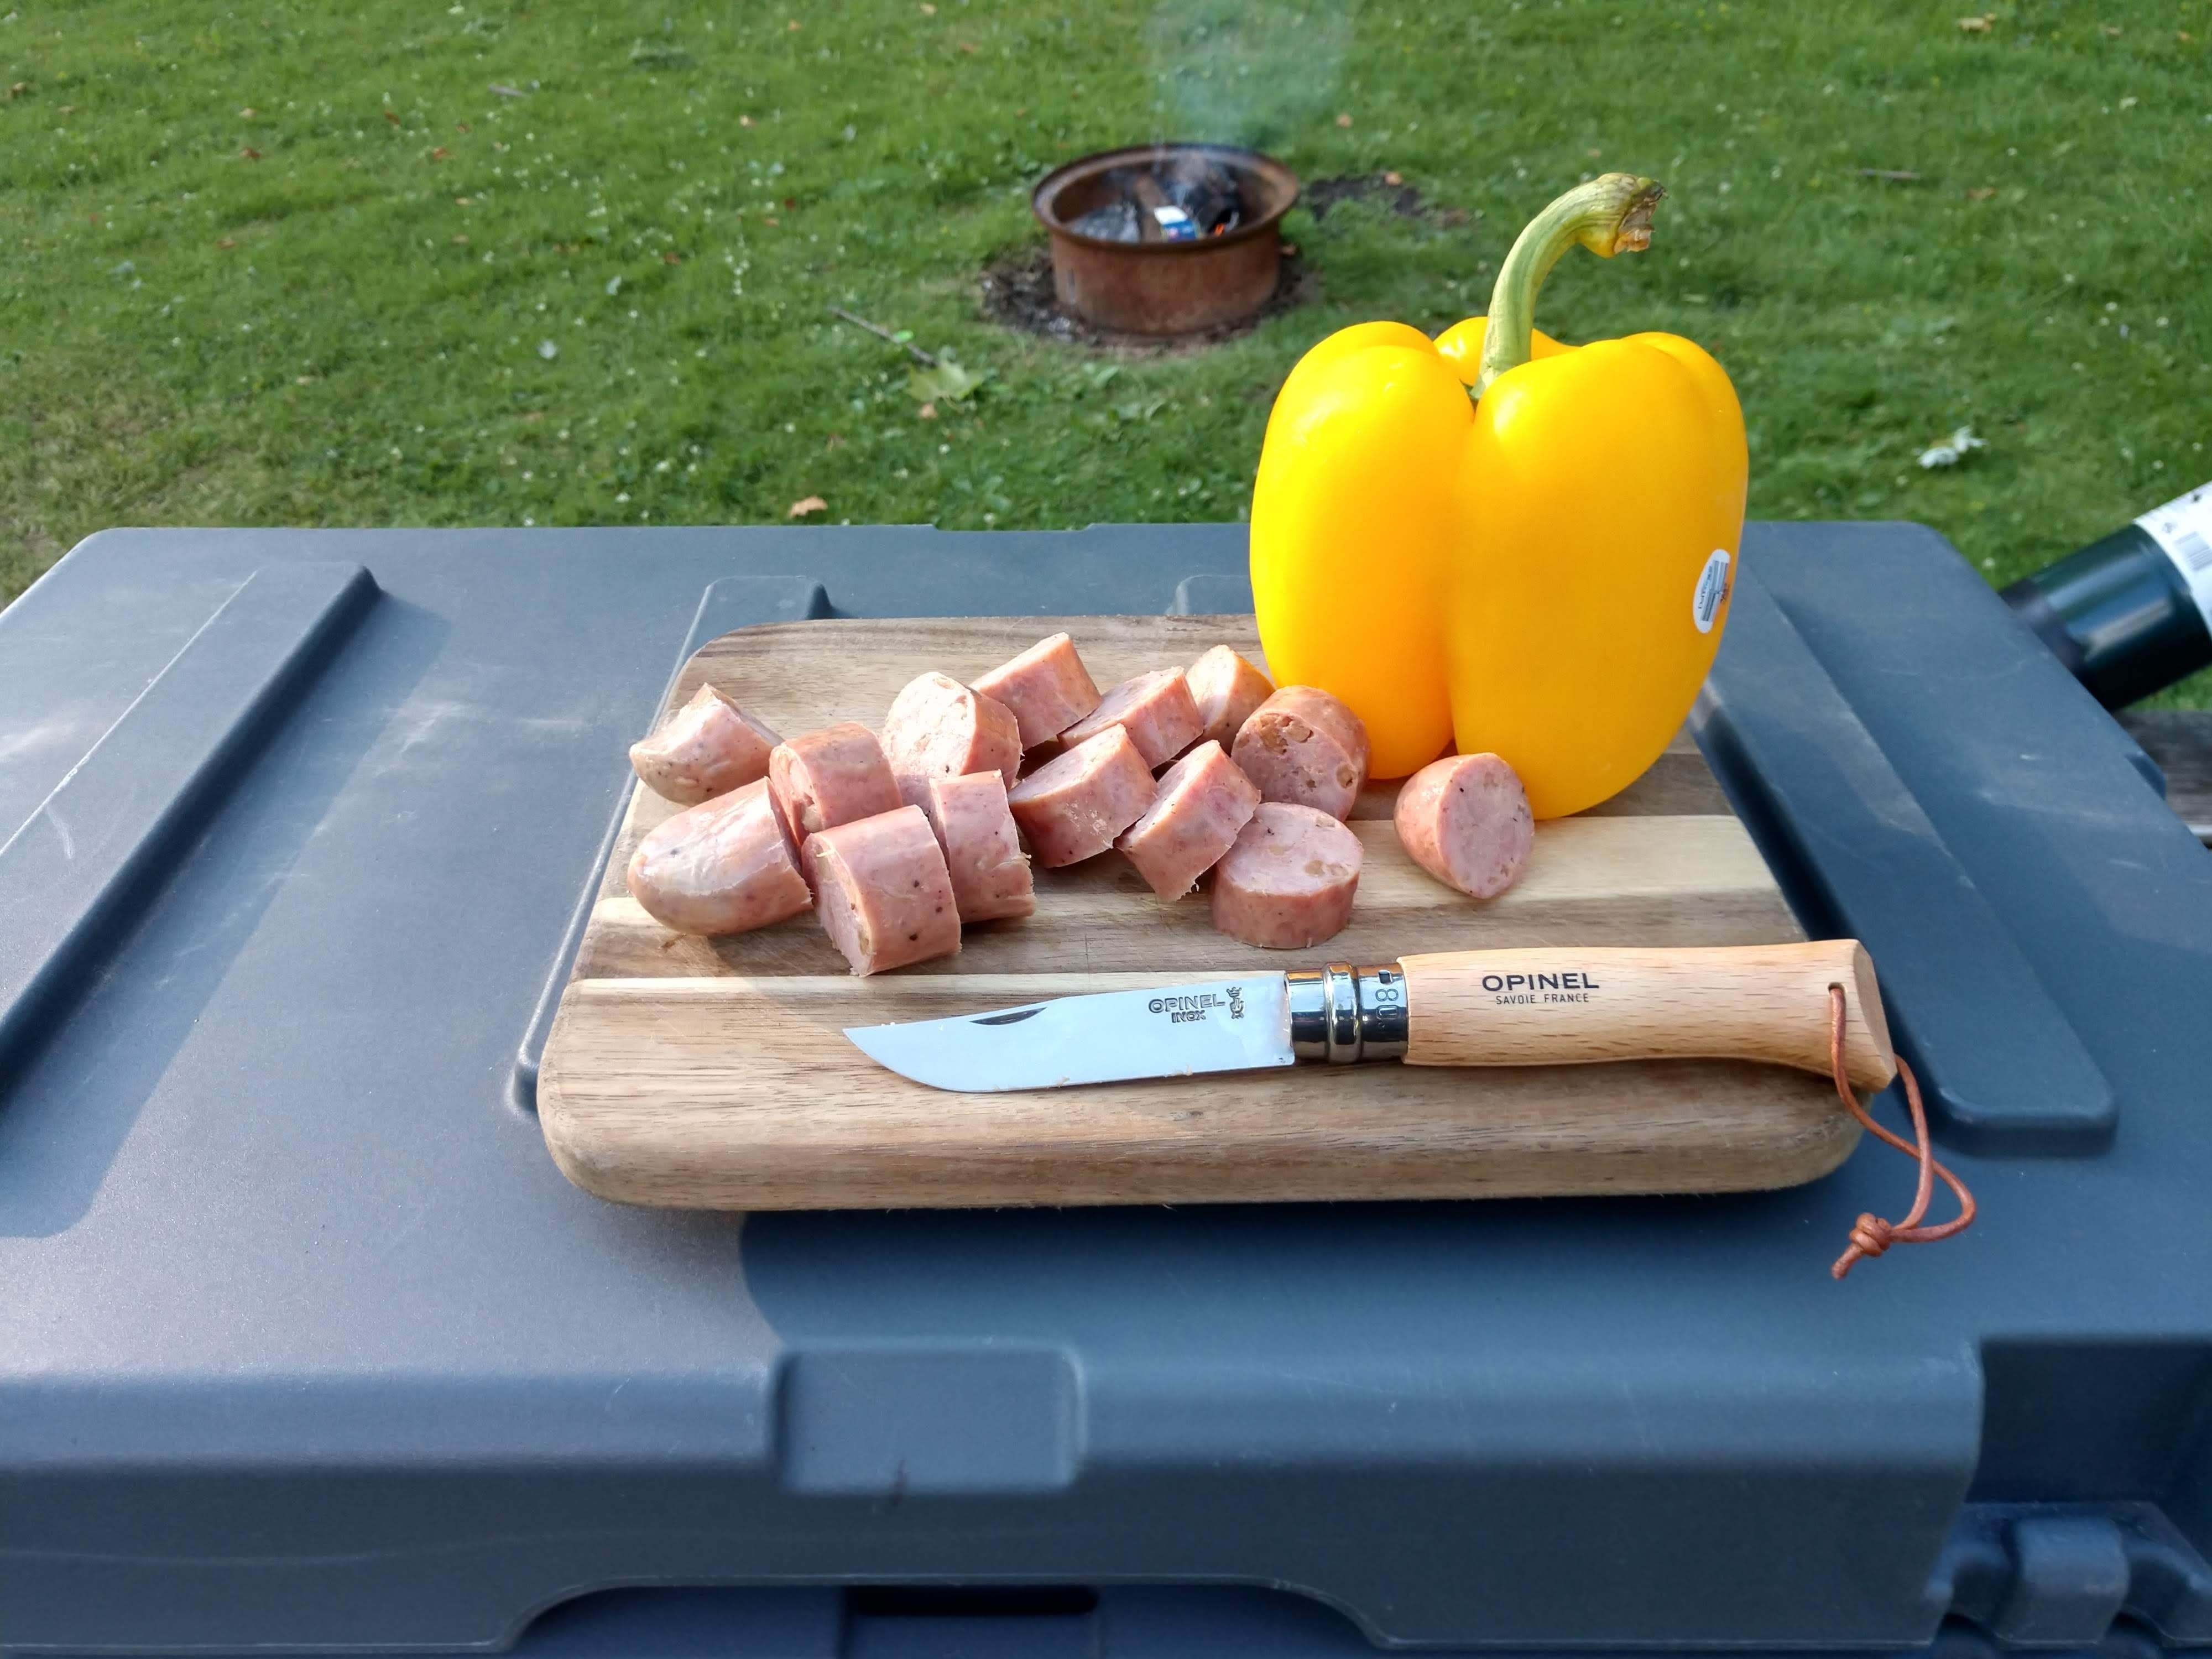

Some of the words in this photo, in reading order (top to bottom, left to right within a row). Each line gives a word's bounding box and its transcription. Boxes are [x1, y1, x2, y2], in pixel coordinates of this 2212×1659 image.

[1482, 973, 1599, 992] OPINEL
[1149, 994, 1225, 1014] OPINEL
[1496, 994, 1536, 1004] SAVOIE
[1544, 993, 1589, 1003] FRANCE
[1171, 1010, 1206, 1023] INOX
